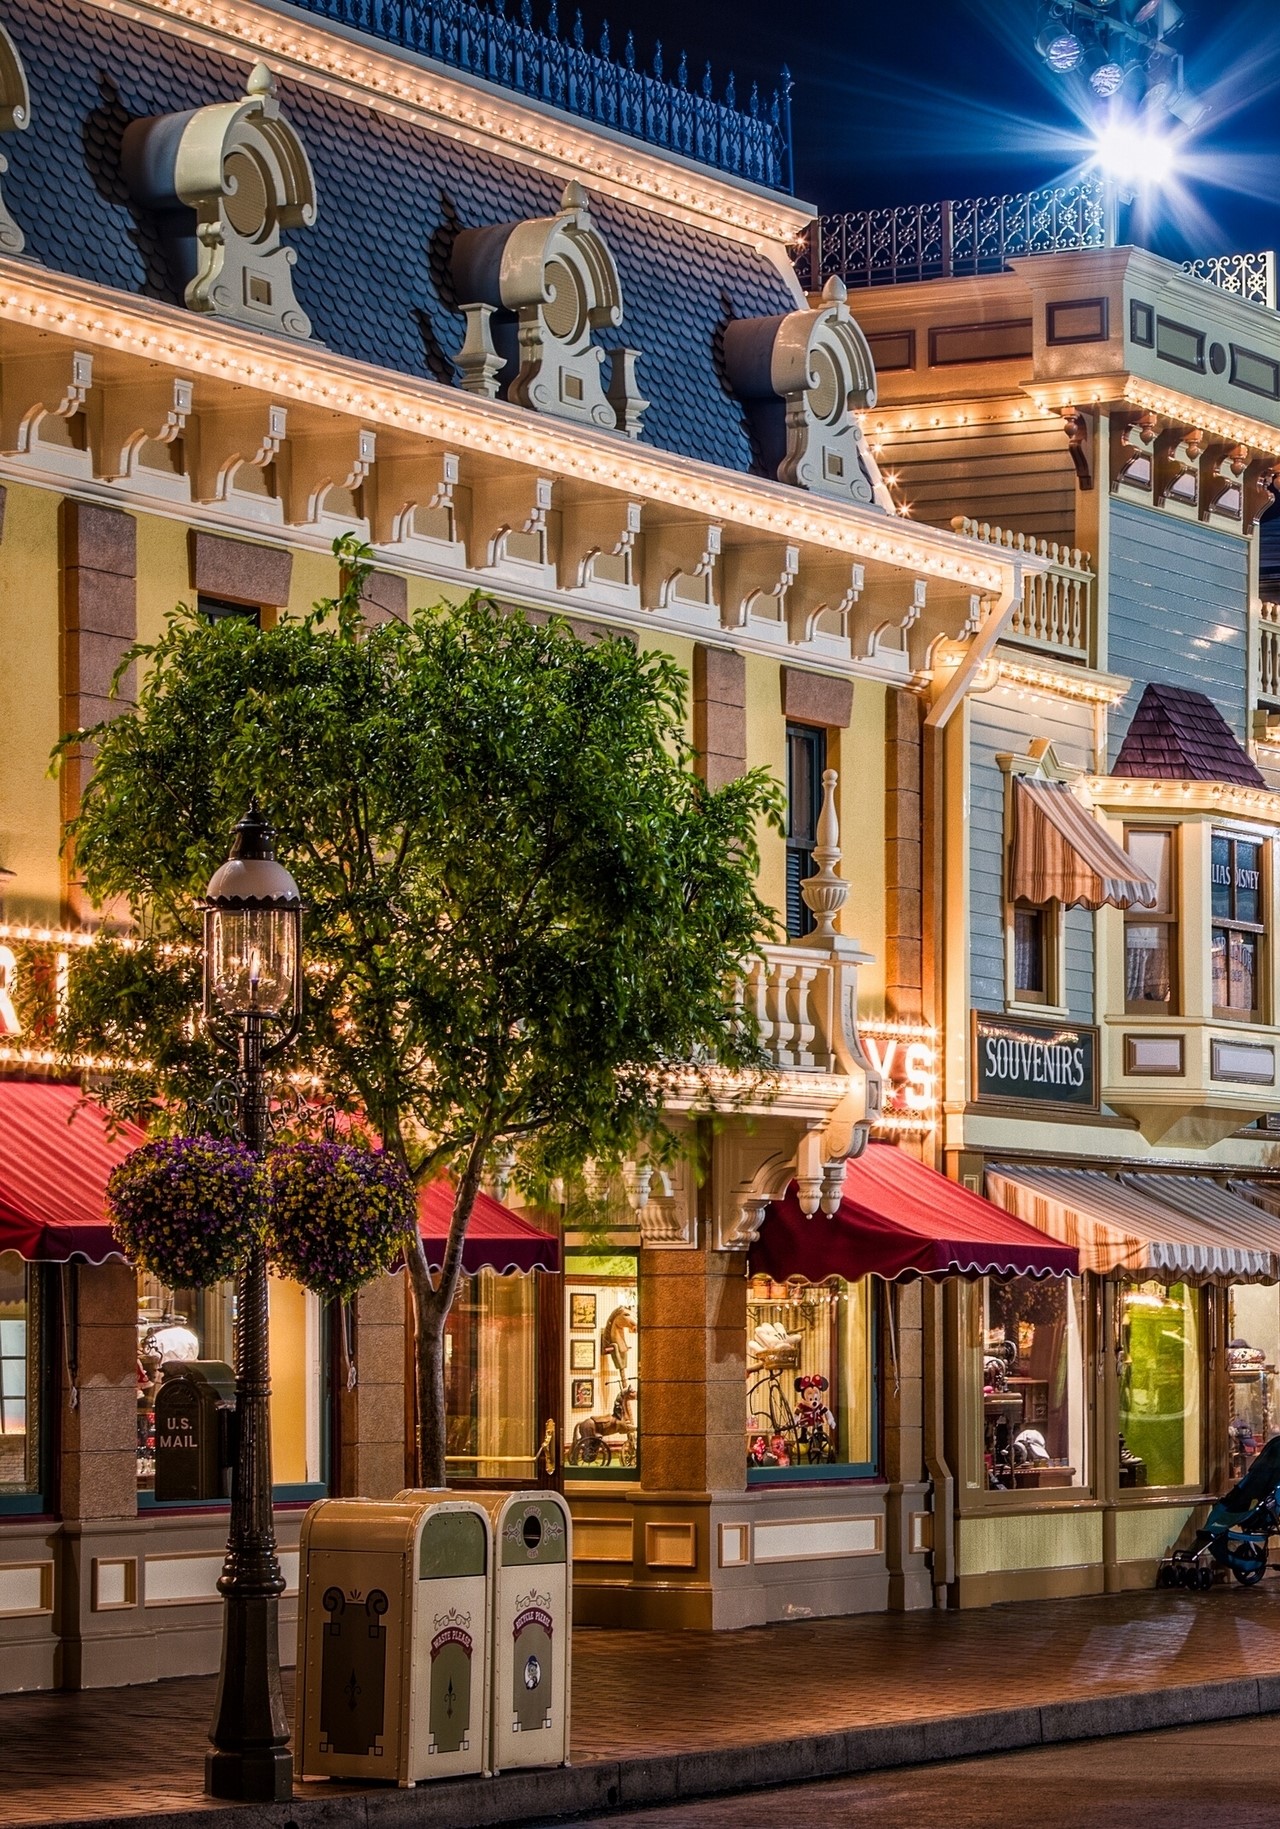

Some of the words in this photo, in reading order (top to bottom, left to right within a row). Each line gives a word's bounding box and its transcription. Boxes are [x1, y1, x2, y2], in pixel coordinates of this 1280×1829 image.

[1212, 863, 1231, 885] LIAS
[985, 1037, 1085, 1087] SOUVENIRS
[167, 1417, 193, 1430] U.S.
[160, 1435, 198, 1448] MAIL
[535, 1611, 551, 1627] PLEASE
[433, 1631, 451, 1649] WASTE
[452, 1630, 471, 1648] PLEASE
